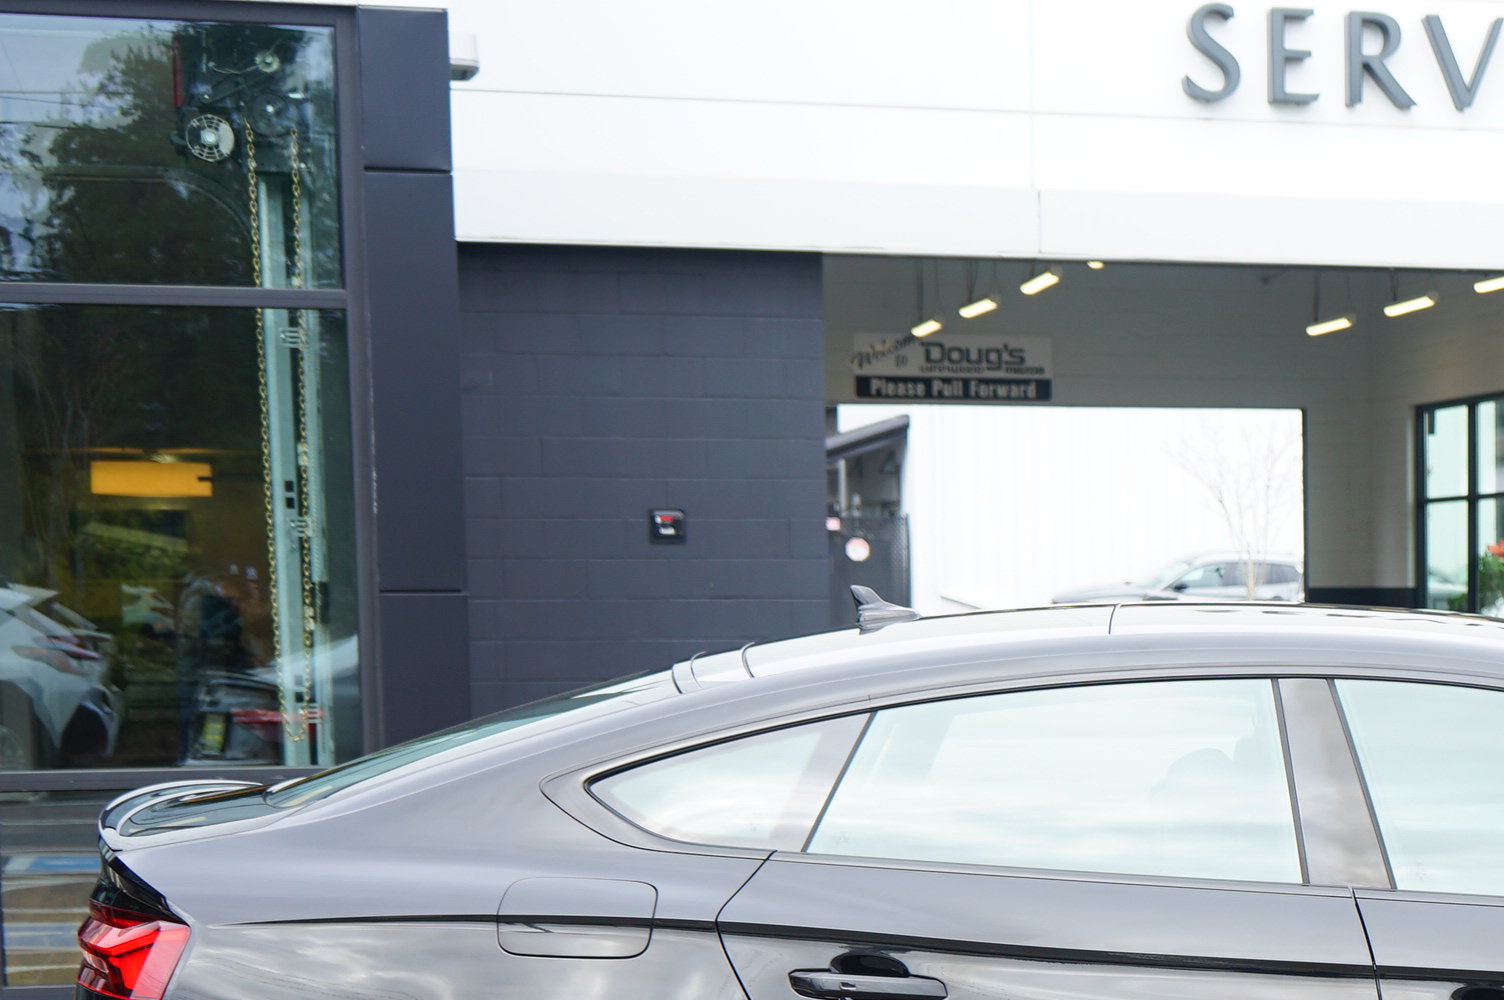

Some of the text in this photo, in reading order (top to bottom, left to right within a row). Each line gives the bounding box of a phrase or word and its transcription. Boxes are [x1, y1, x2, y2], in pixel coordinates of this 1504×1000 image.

[920, 341, 1026, 371] Doug's
[871, 378, 1037, 399] Please Pull Forward
